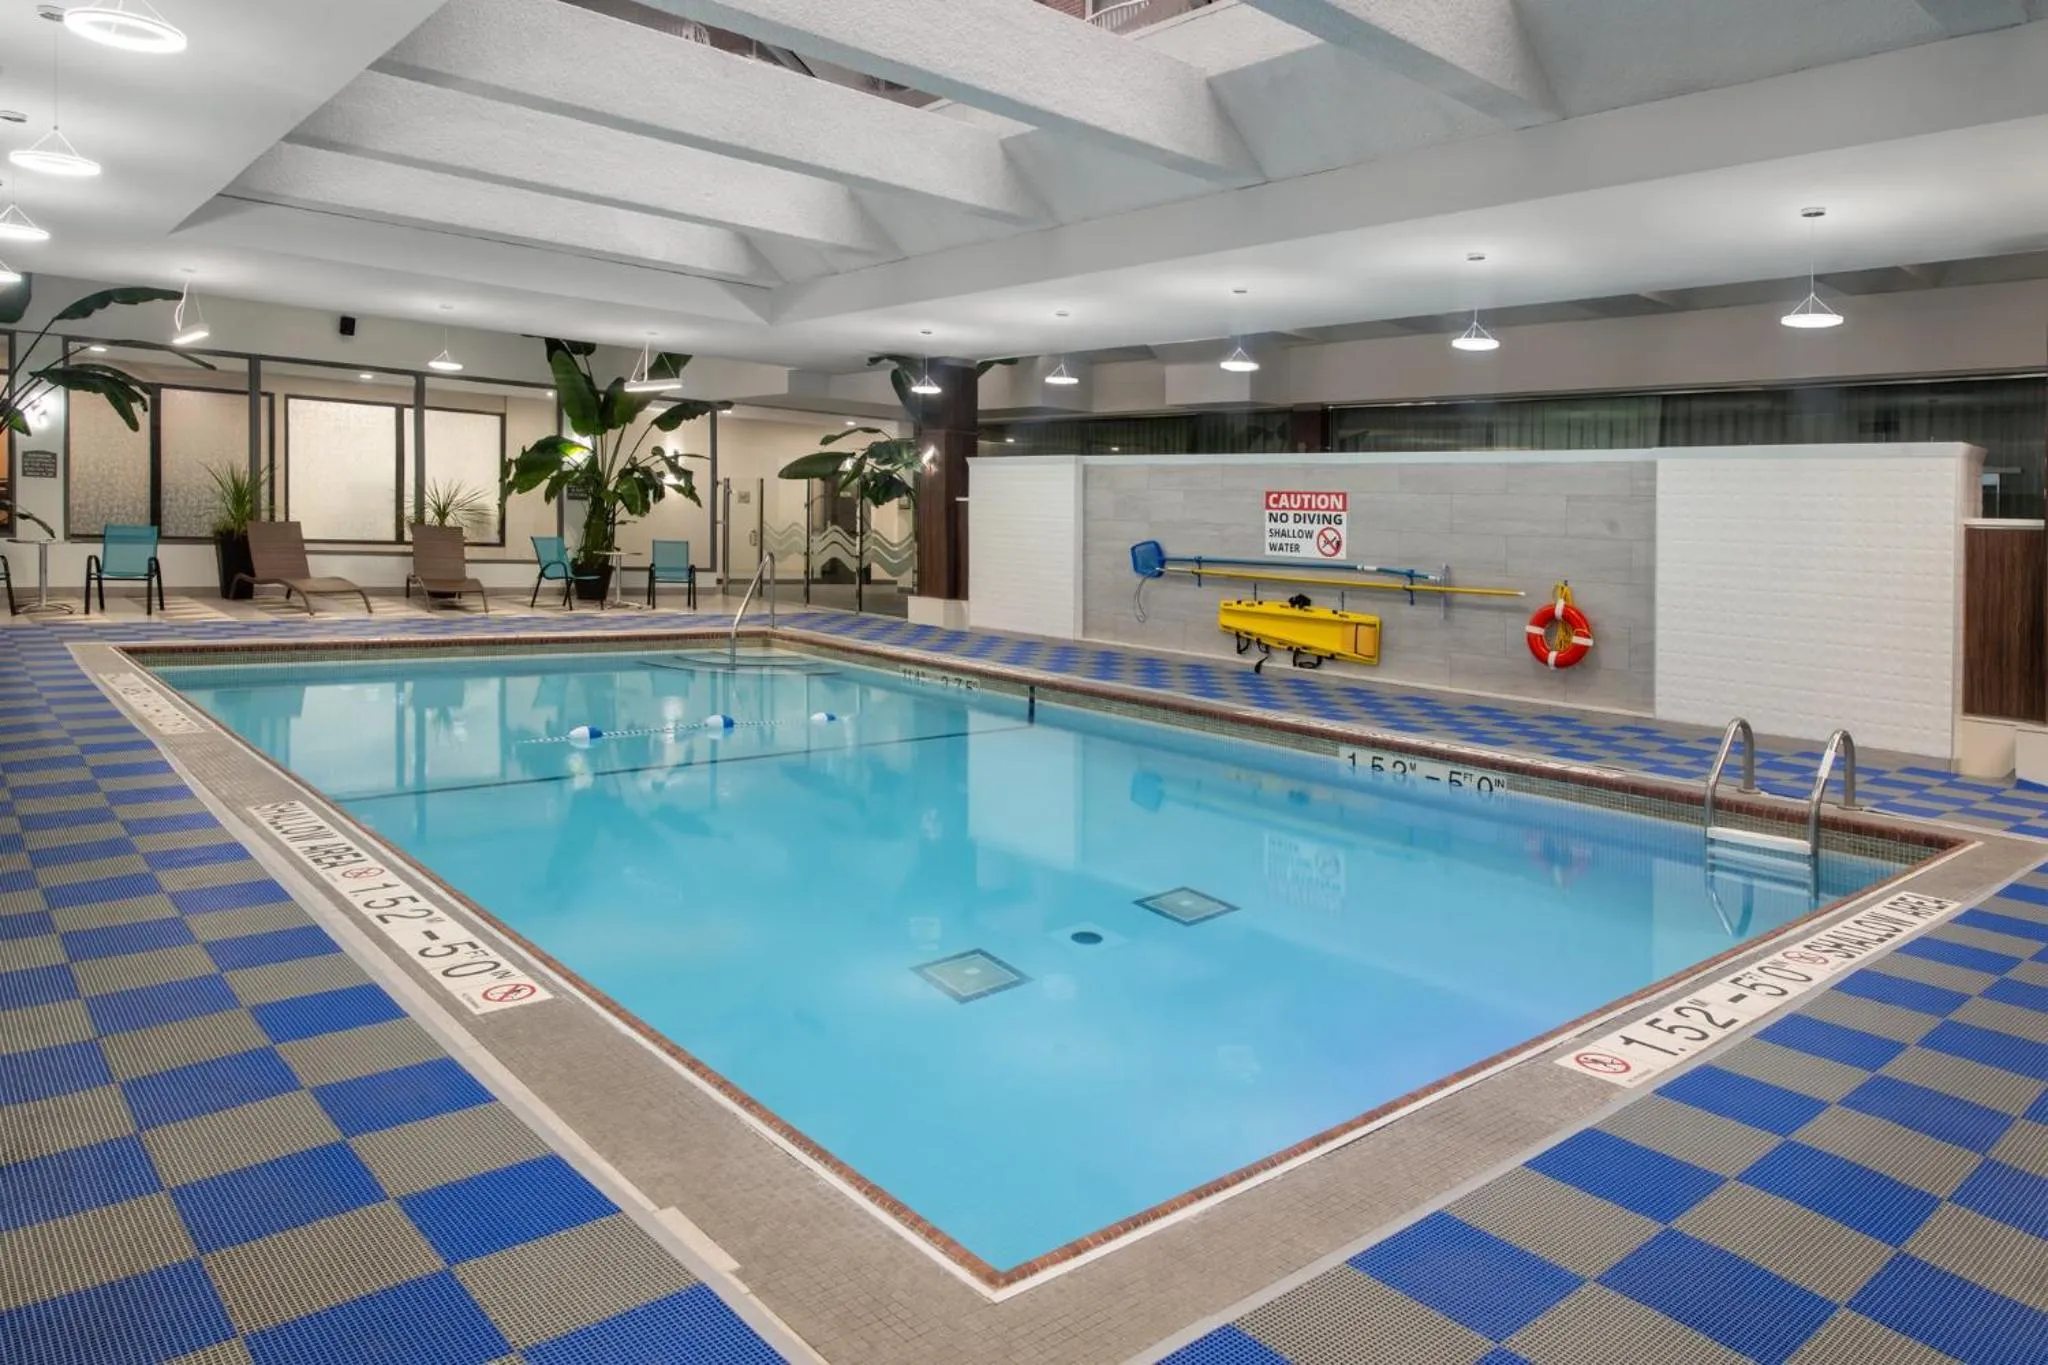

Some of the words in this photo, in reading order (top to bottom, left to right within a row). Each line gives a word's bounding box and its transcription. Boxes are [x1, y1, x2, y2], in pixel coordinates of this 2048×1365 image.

[1268, 493, 1343, 510] CAUTION
[1268, 512, 1289, 524] NO
[1293, 513, 1343, 525] DIVING
[1268, 528, 1314, 540] SHALLOW
[1268, 542, 1301, 553] WATER
[297, 843, 368, 870] AREA
[1803, 911, 1918, 960] SHALLOW
[1882, 893, 1954, 920] AREA
